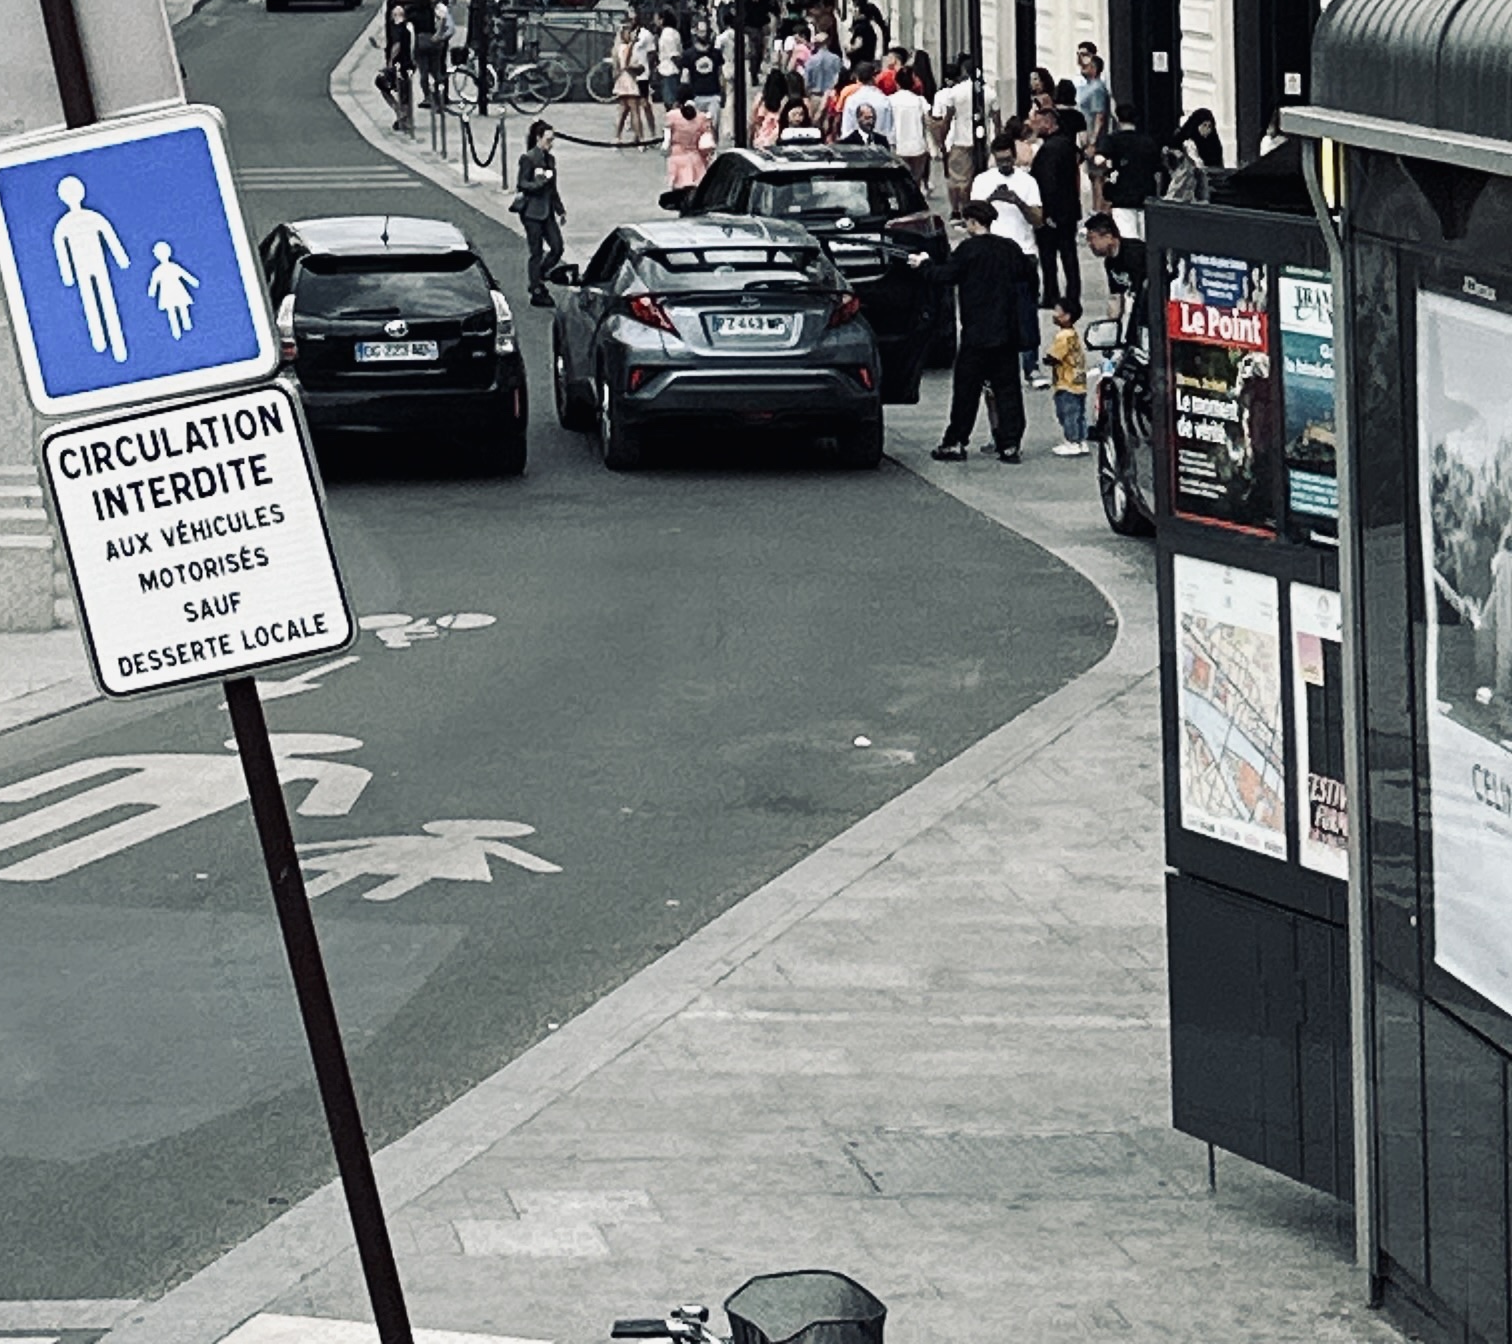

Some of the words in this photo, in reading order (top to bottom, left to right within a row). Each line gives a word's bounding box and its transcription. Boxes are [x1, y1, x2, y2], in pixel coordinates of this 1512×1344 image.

[1179, 301, 1206, 335] Le
[1206, 305, 1263, 345] Point
[1175, 388, 1191, 413] Le
[58, 401, 285, 480] CIRCULATION
[91, 453, 273, 521] INTERDITE
[106, 532, 153, 562] AUX
[160, 503, 286, 548] VÉHICULES
[138, 545, 270, 593] MOTORISÉS
[183, 591, 242, 623] SAUF
[117, 633, 235, 677] DESSERTE
[240, 612, 329, 651] LOCALE
